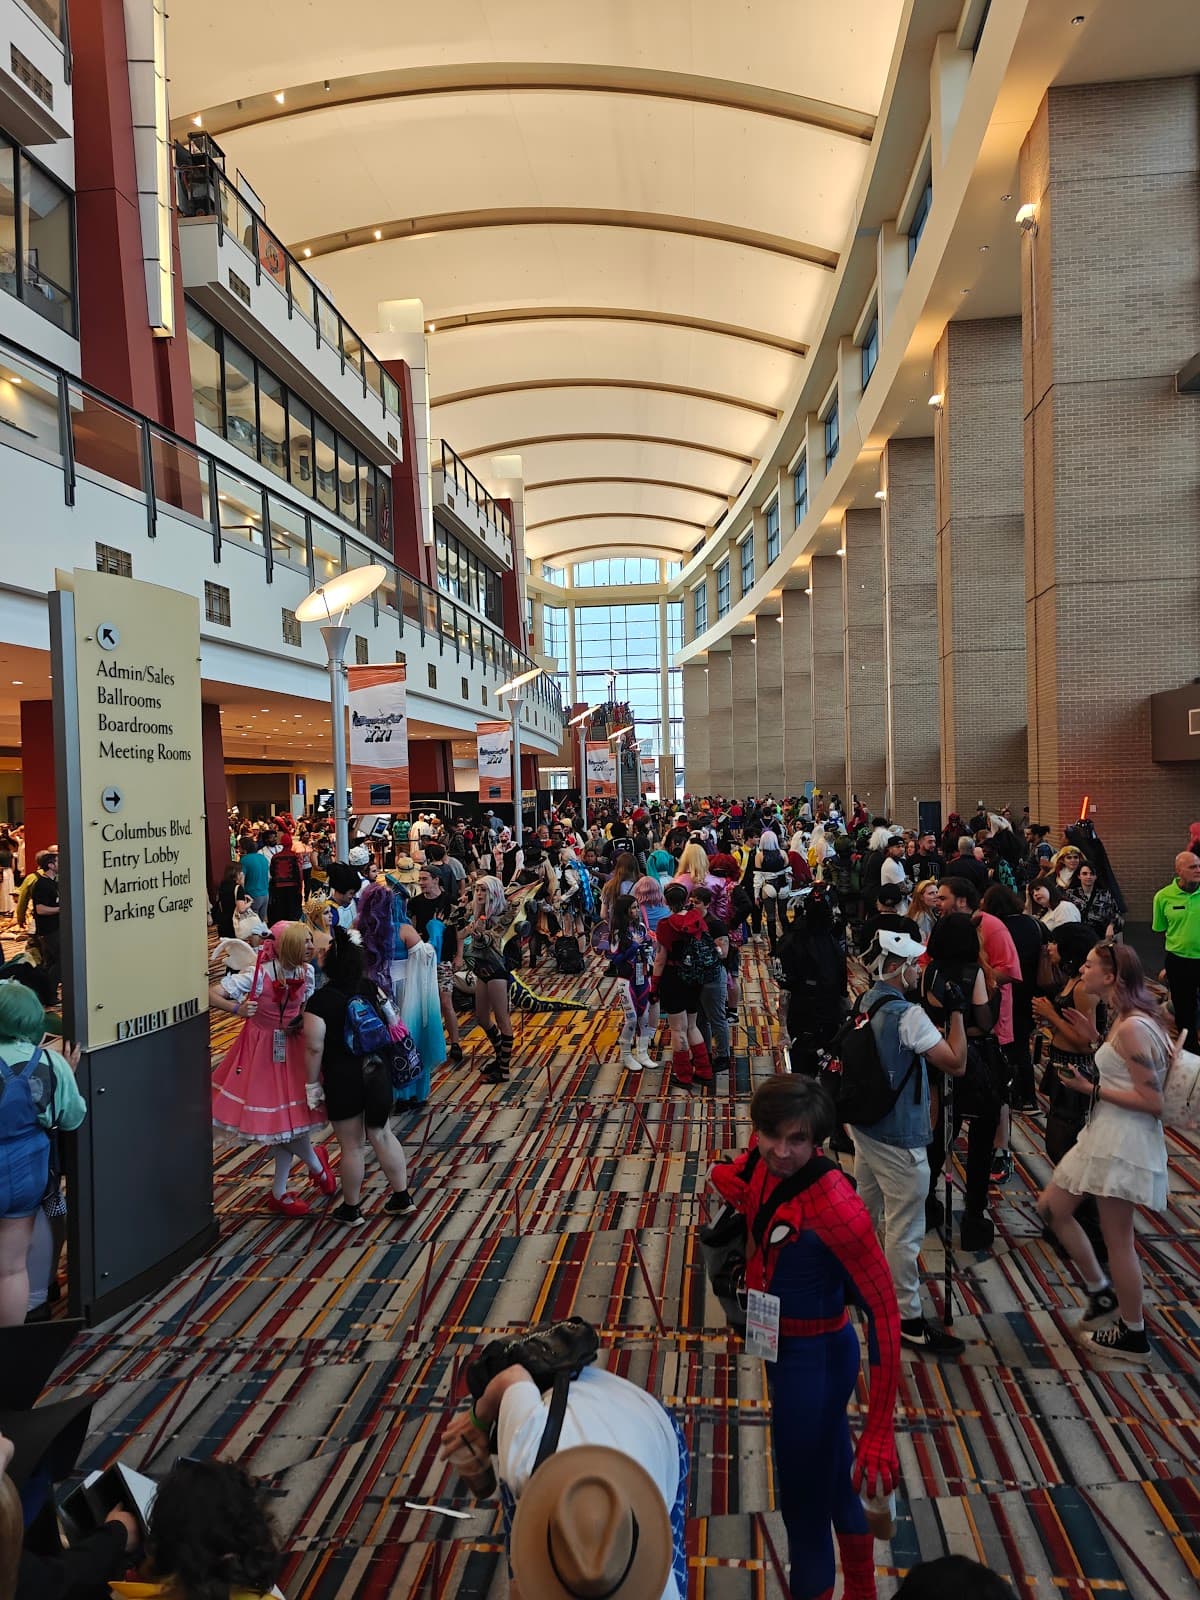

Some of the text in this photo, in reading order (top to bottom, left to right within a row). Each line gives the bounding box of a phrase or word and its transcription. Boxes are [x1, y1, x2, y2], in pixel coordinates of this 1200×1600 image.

[96, 659, 175, 686] Admin/Sales
[97, 686, 162, 709] Ballrooms
[98, 713, 174, 736] Boardrooms
[98, 741, 192, 763] Meeting Rooms
[101, 820, 193, 843] Columbus Blvd.
[102, 846, 180, 870] Entry Lobby
[103, 868, 191, 896] Marriott Hotel
[103, 895, 194, 923] Parking Garage
[117, 1008, 169, 1040] EXHIBIT
